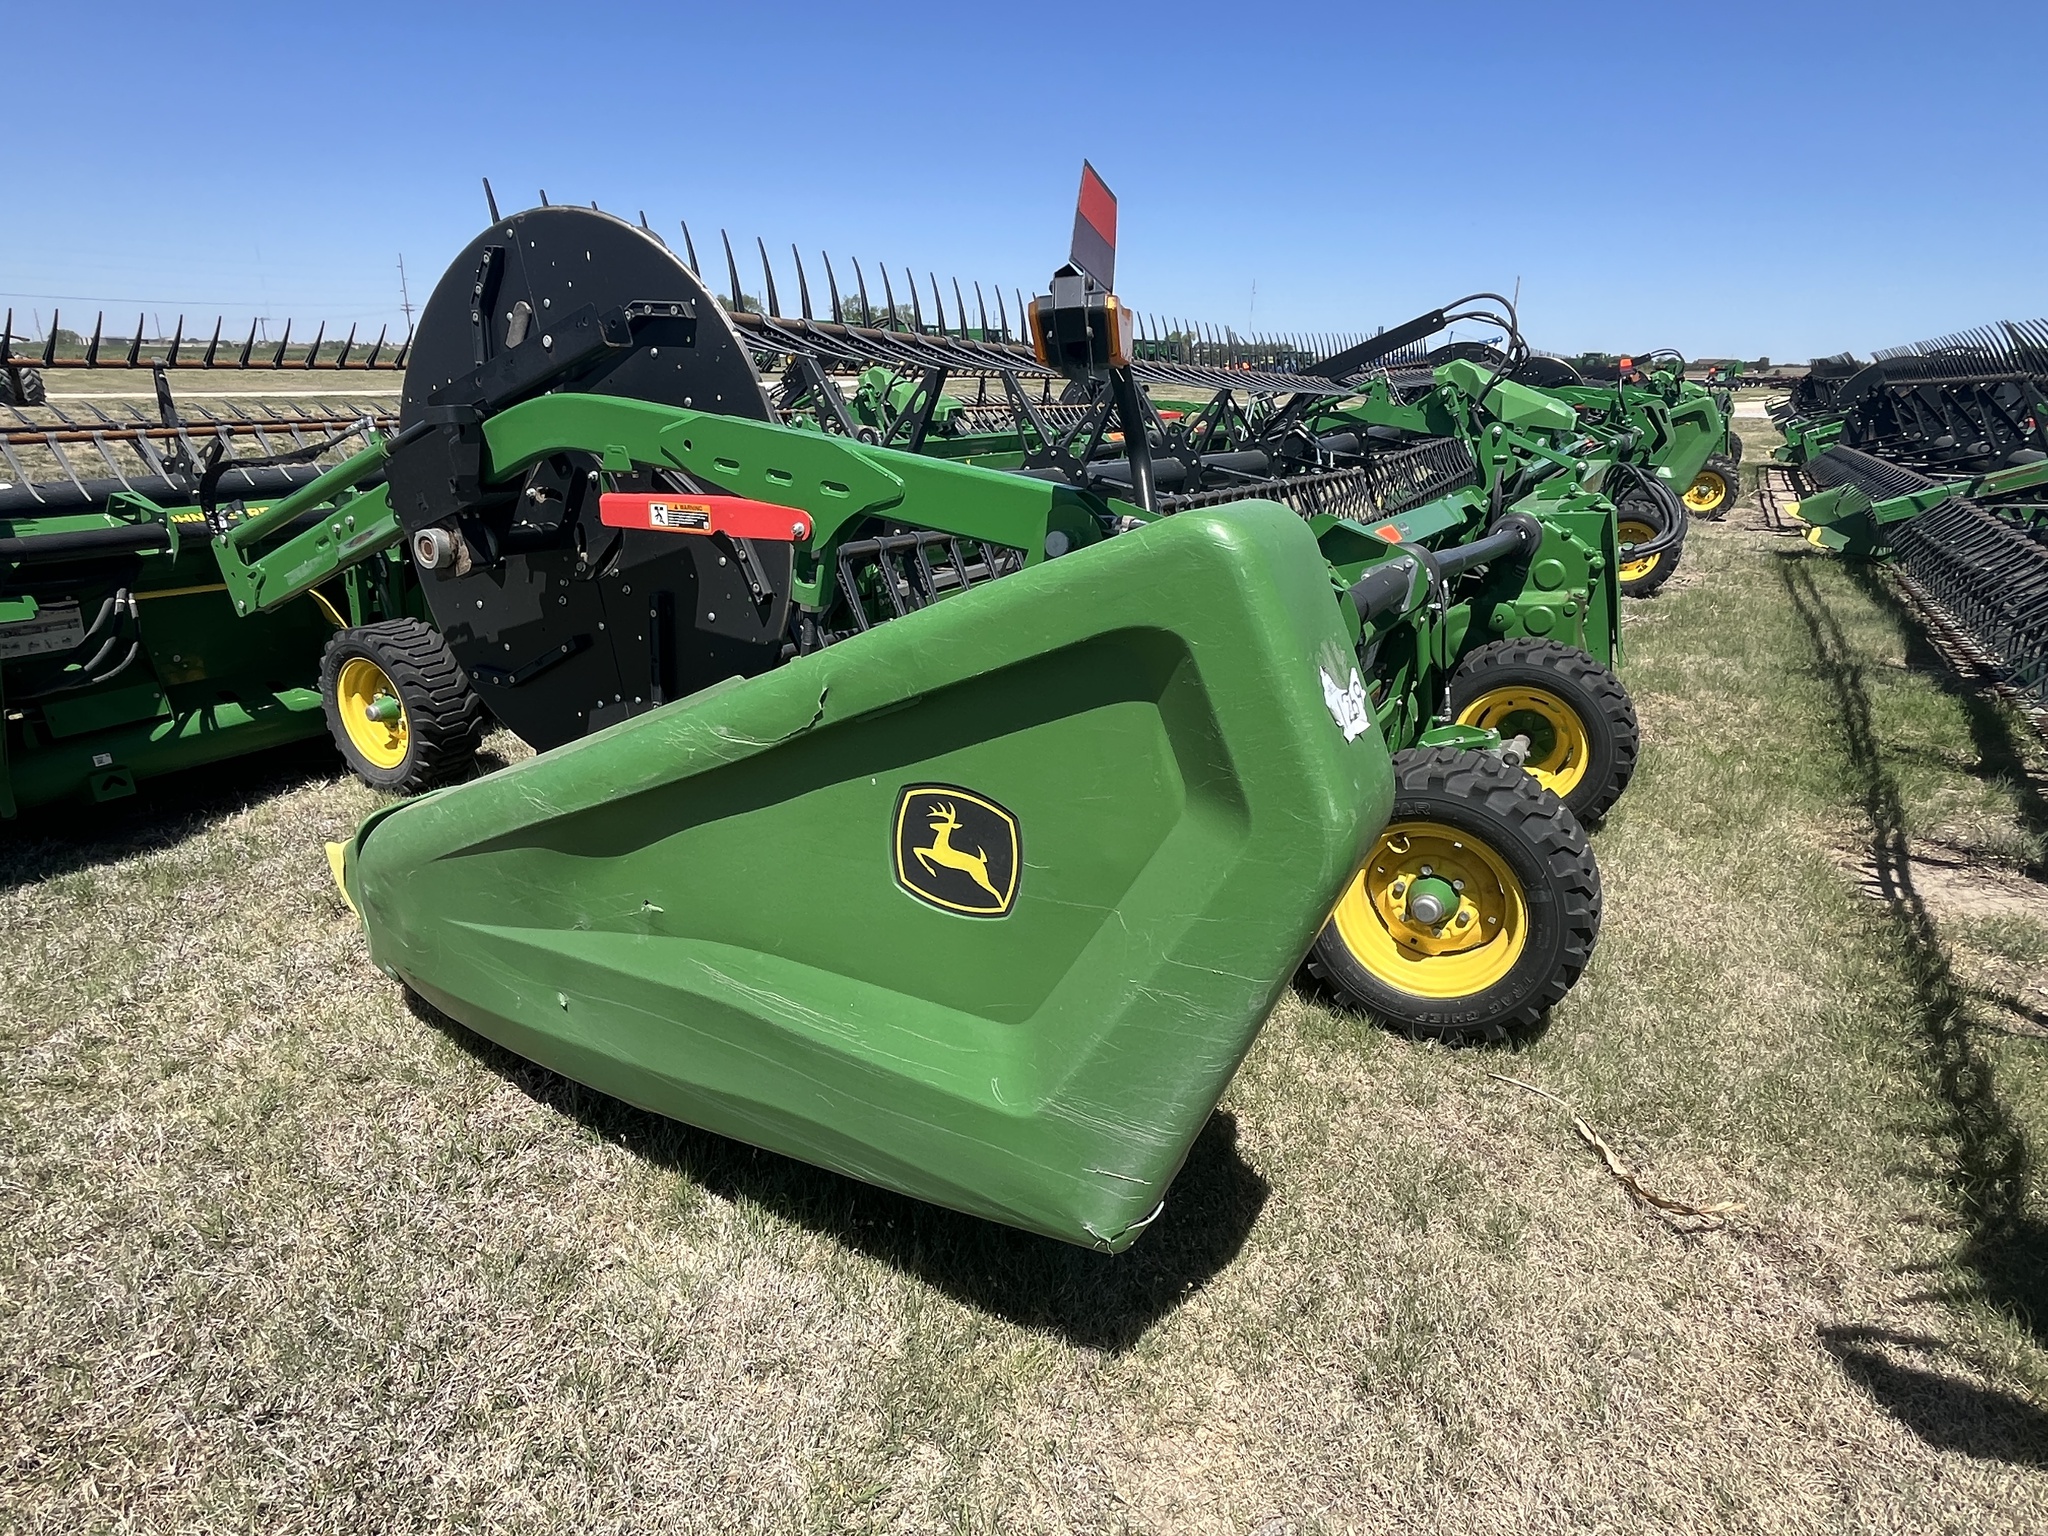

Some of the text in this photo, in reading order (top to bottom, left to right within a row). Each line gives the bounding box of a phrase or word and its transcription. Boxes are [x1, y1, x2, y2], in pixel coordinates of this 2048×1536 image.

[170, 512, 206, 523] HN
[1415, 976, 1535, 1024] TRAC CHIEF
